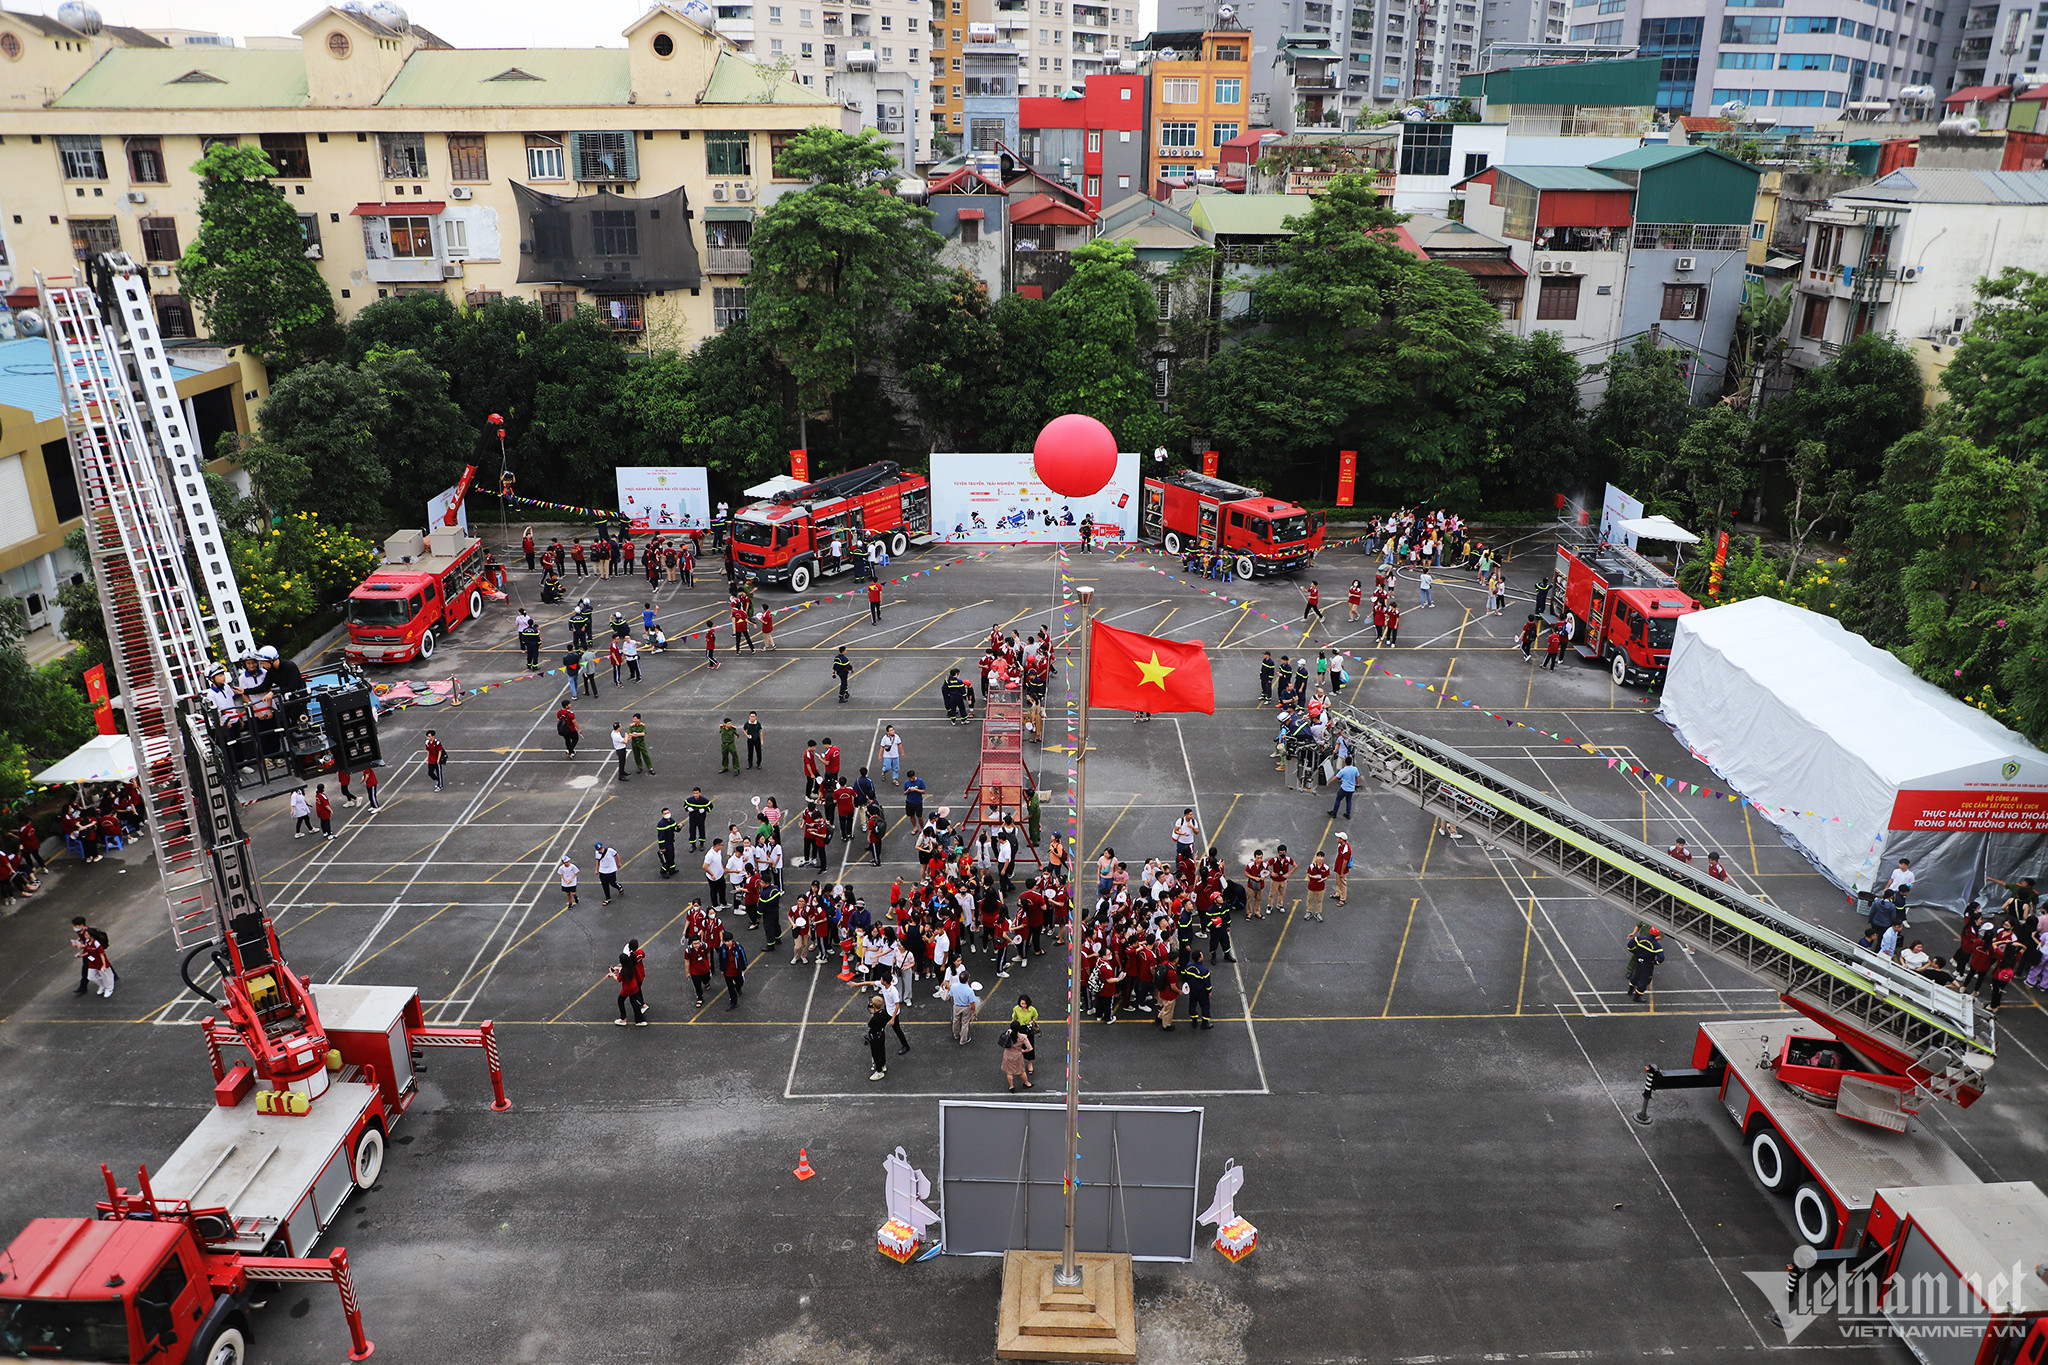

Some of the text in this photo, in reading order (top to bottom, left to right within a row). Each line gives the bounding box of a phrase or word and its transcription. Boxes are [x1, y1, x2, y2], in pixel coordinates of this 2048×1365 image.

[1455, 794, 1496, 817] MORITA
[1922, 810, 1947, 819] THỰC
[1948, 809, 1976, 818] HÀNH
[1977, 810, 1990, 819] KỸ
[1991, 810, 2019, 819] NĂNG
[1947, 819, 1967, 828] MÔI
[1968, 819, 2006, 828] TRƯỜNG
[2007, 820, 2033, 830] KHÓI,
